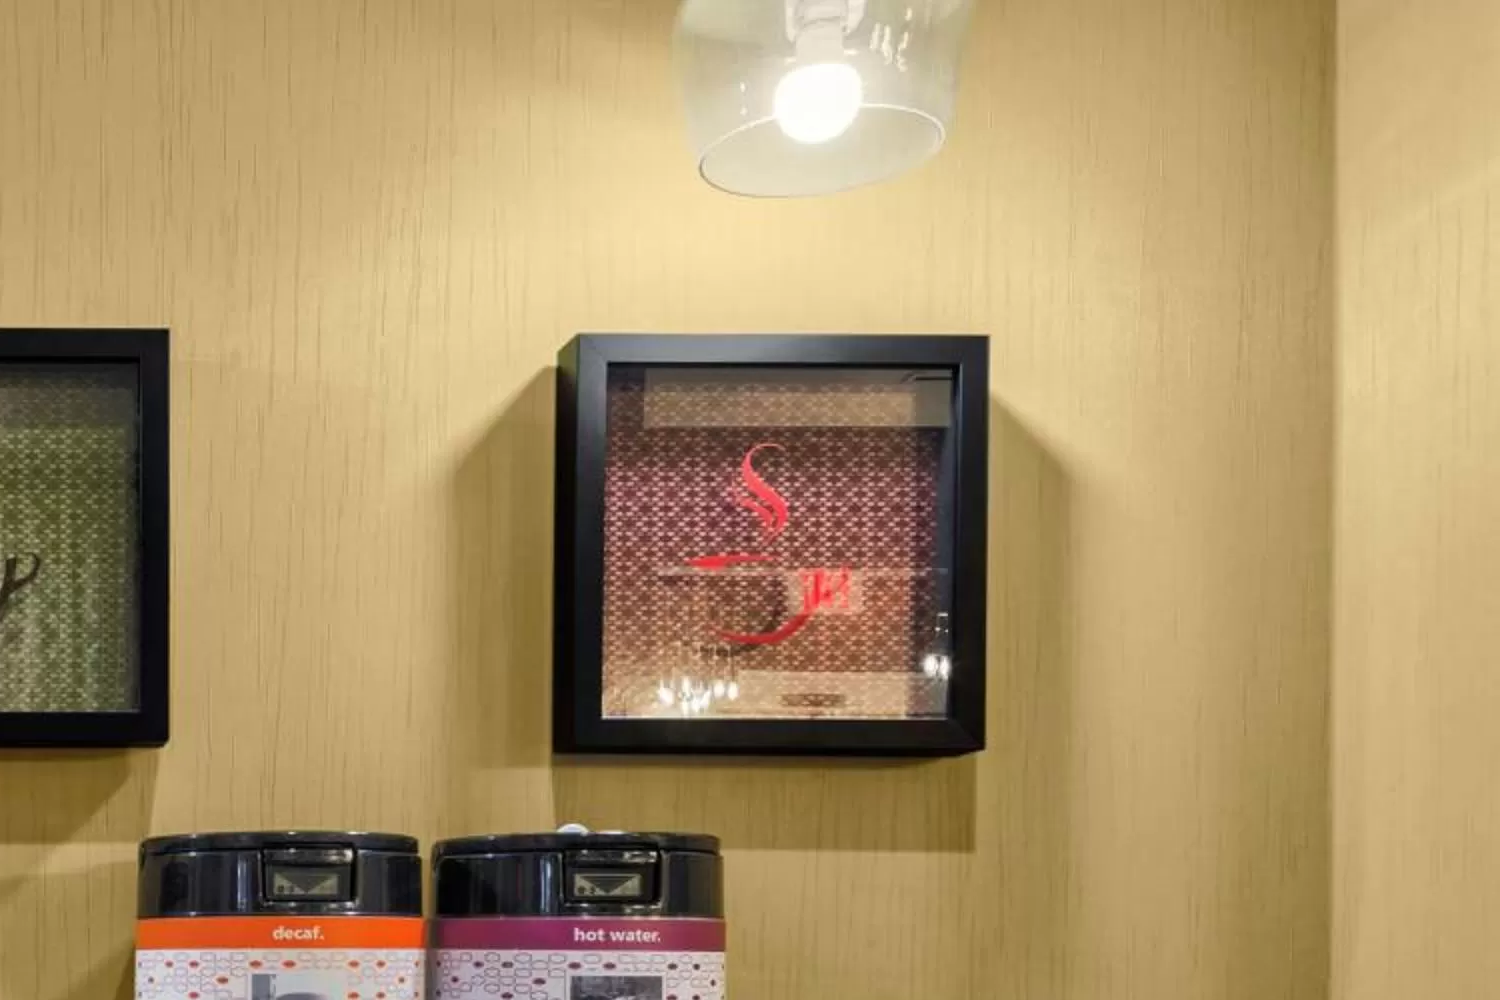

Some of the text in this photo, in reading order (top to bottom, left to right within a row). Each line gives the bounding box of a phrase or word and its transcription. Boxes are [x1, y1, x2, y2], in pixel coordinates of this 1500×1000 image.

[272, 925, 325, 941] decaf.
[573, 927, 661, 942] hot water.
